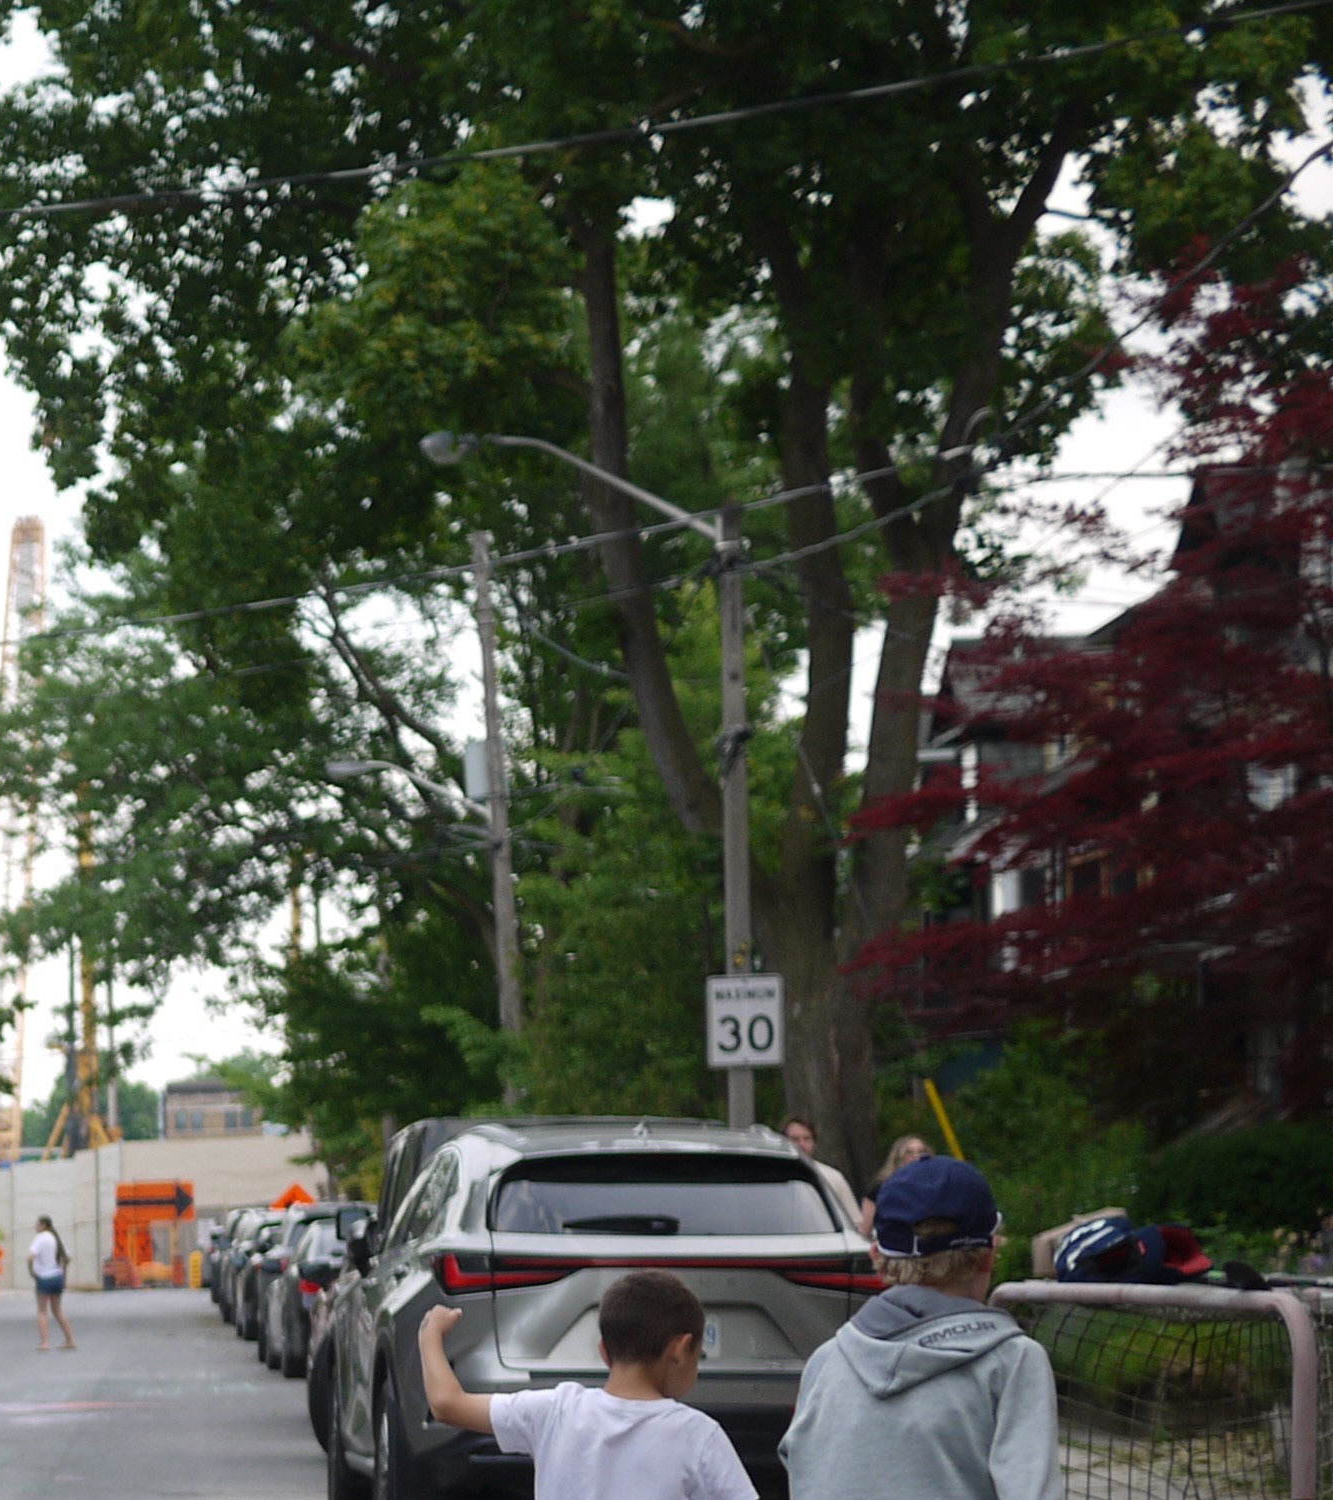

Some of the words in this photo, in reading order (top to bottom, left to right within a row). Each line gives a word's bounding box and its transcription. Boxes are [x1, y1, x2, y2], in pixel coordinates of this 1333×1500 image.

[715, 988, 776, 1000] MAXIMUM
[718, 1014, 774, 1053] 30
[918, 1321, 997, 1347] RMOUR
